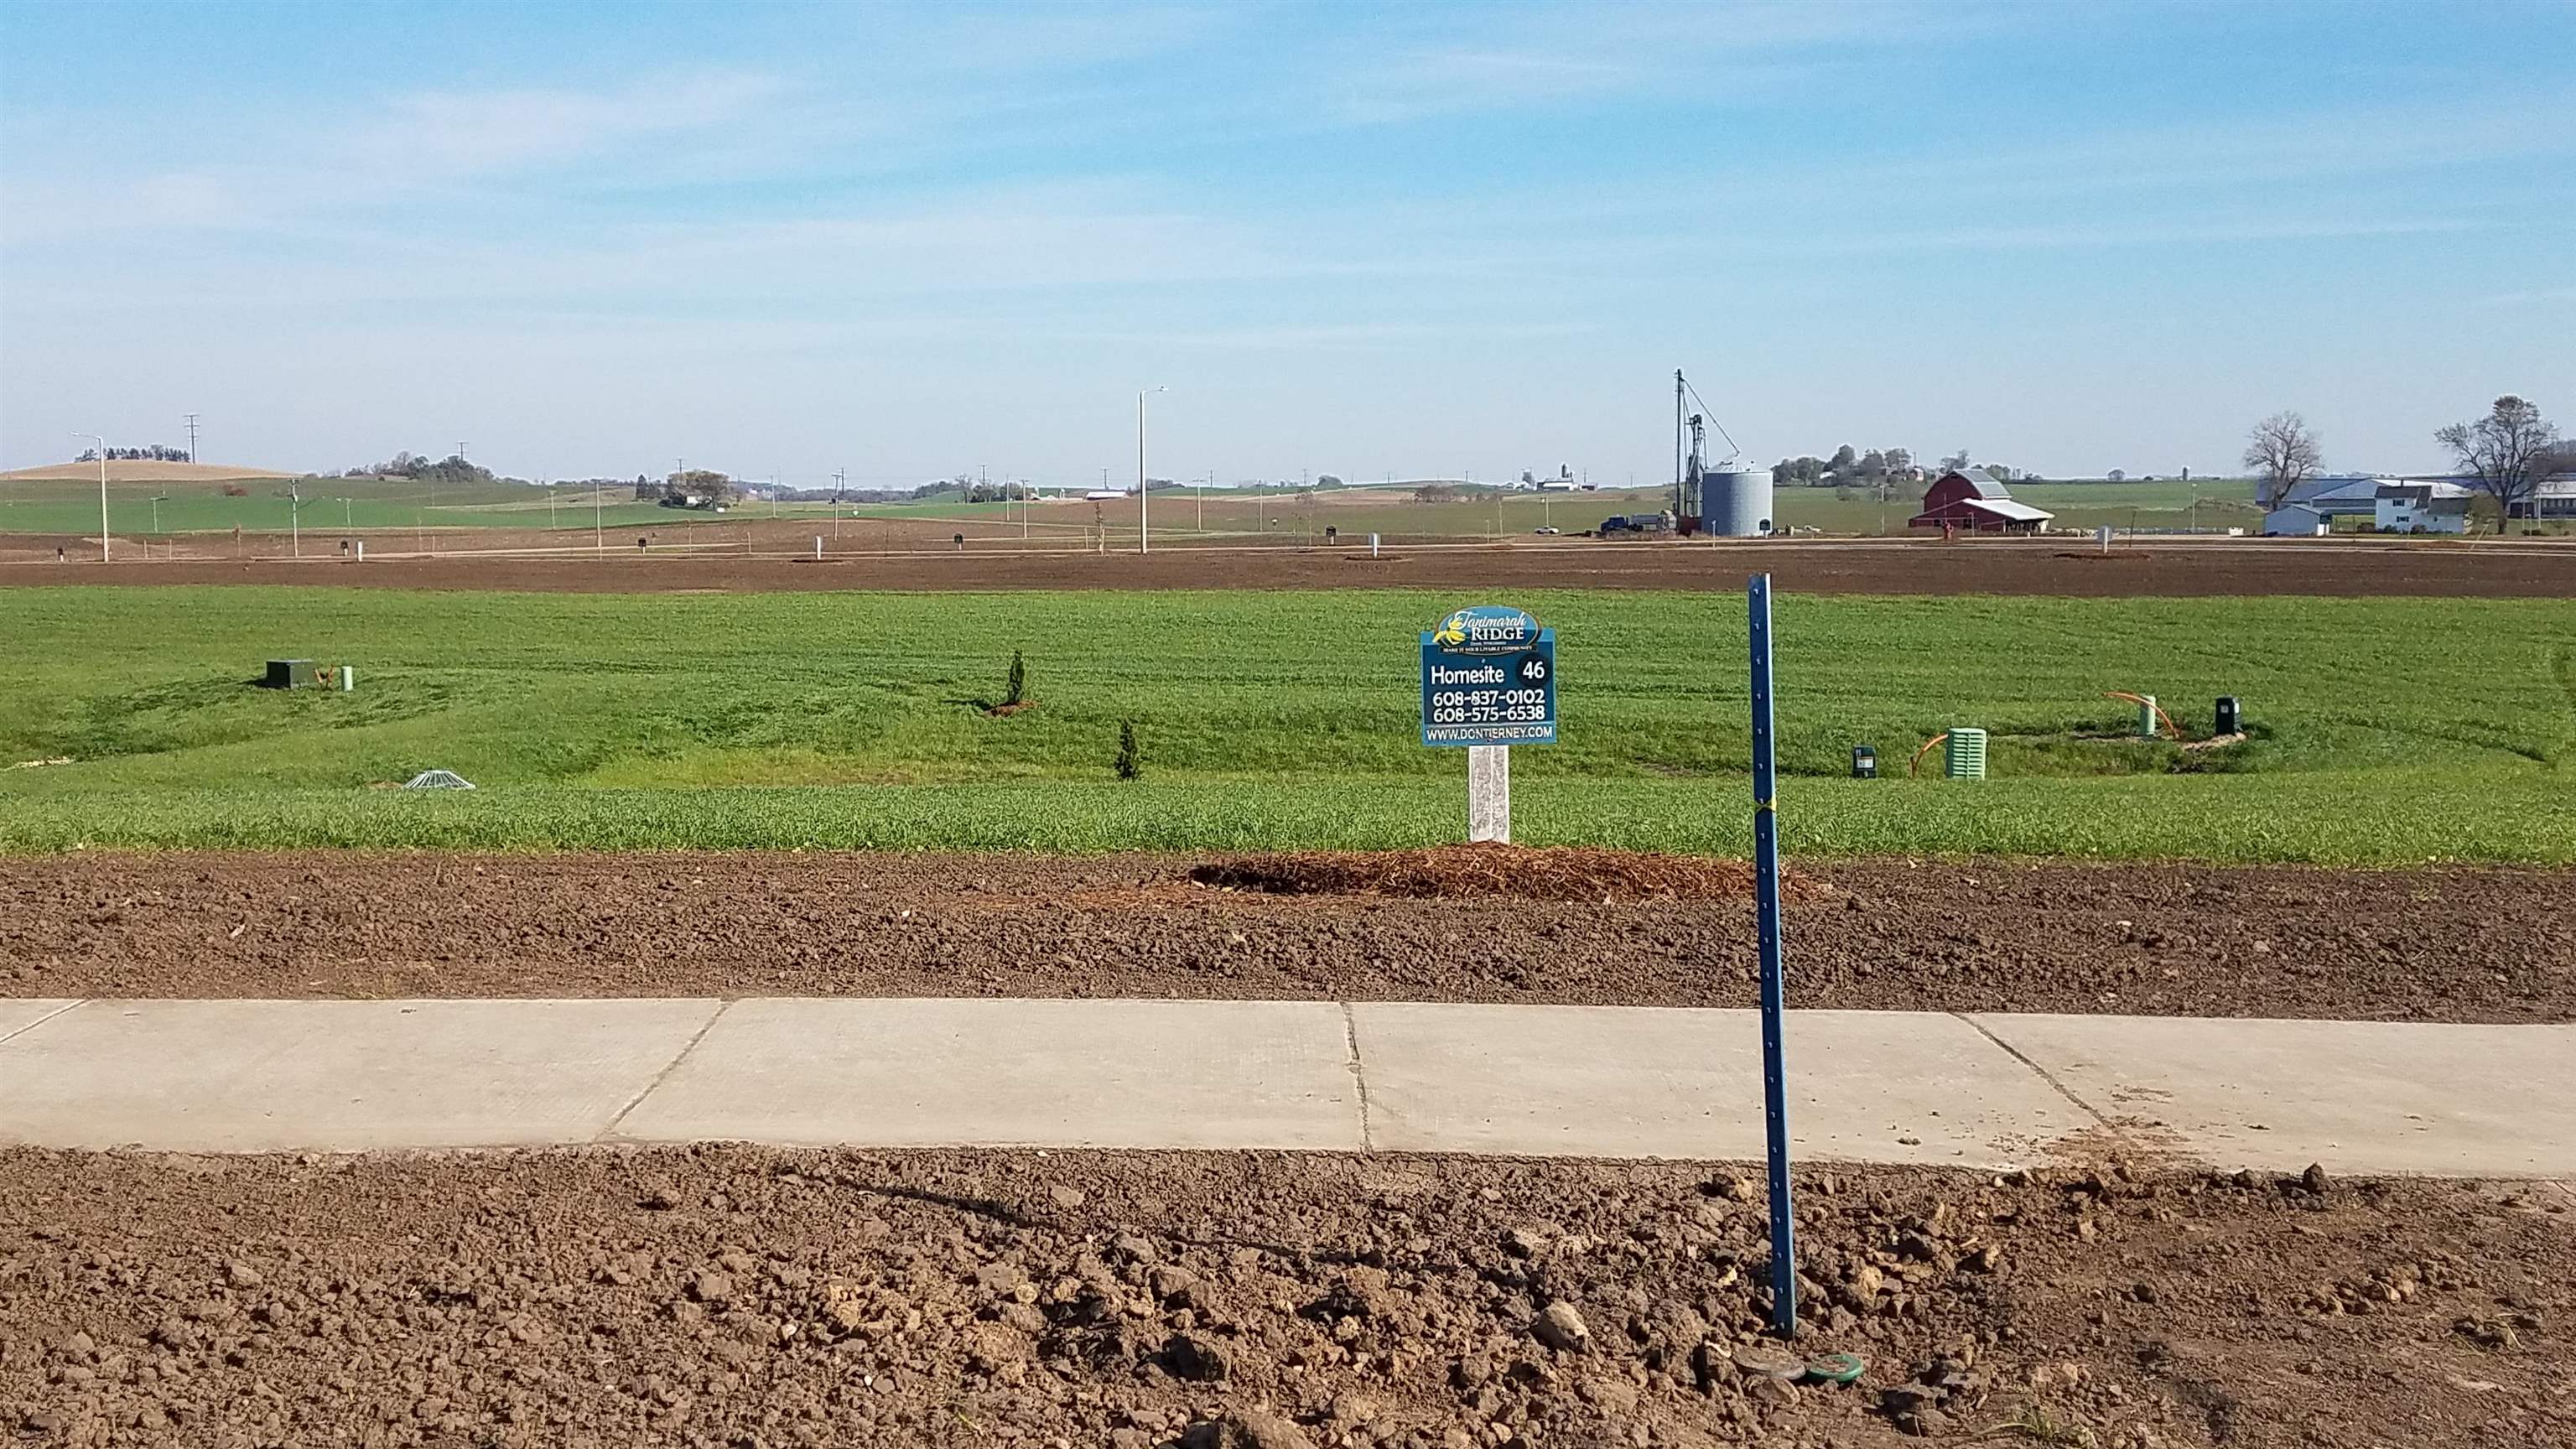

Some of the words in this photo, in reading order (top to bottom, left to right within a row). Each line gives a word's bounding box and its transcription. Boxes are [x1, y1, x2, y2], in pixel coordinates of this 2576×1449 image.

[1472, 627, 1524, 641] RIDGE
[1431, 665, 1504, 684] Homesite
[1523, 662, 1545, 679] 46
[1432, 688, 1545, 706] 608-837-0102
[1433, 705, 1545, 722] 608-575-6538
[1426, 727, 1552, 740] WWW.DONTIERNEY.COM
